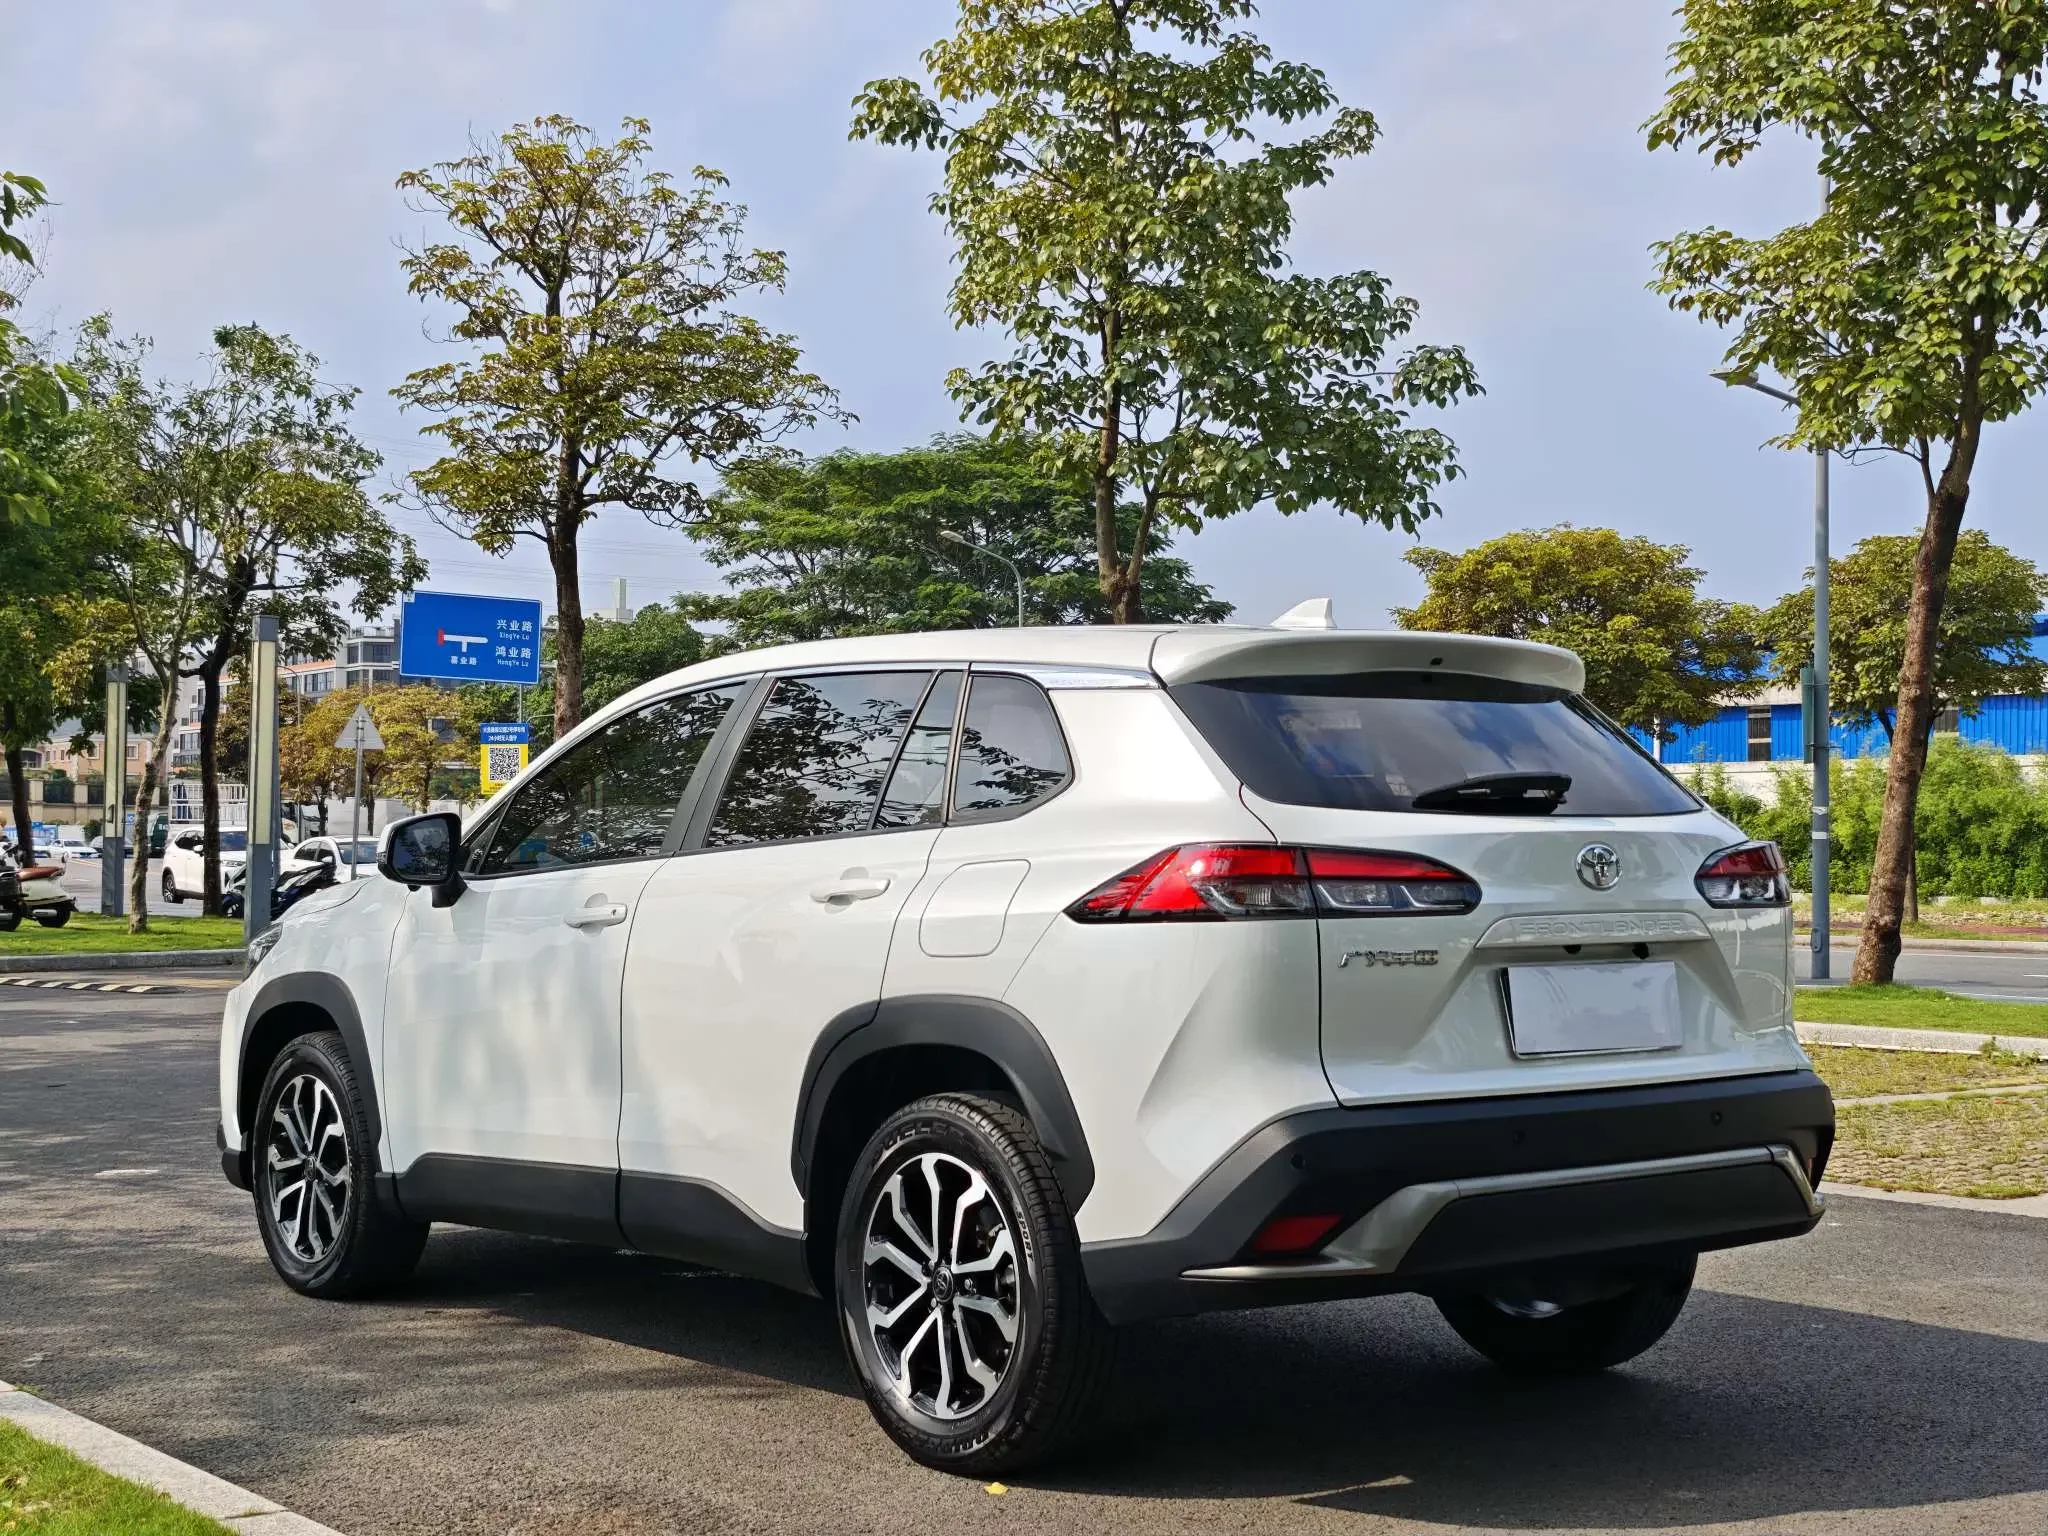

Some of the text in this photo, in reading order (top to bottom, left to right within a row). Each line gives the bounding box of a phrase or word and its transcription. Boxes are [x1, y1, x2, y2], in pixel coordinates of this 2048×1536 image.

[497, 619, 532, 632] 兴业路
[495, 646, 532, 659] 鸿业路
[1519, 918, 1687, 936] FRONTLANDER
